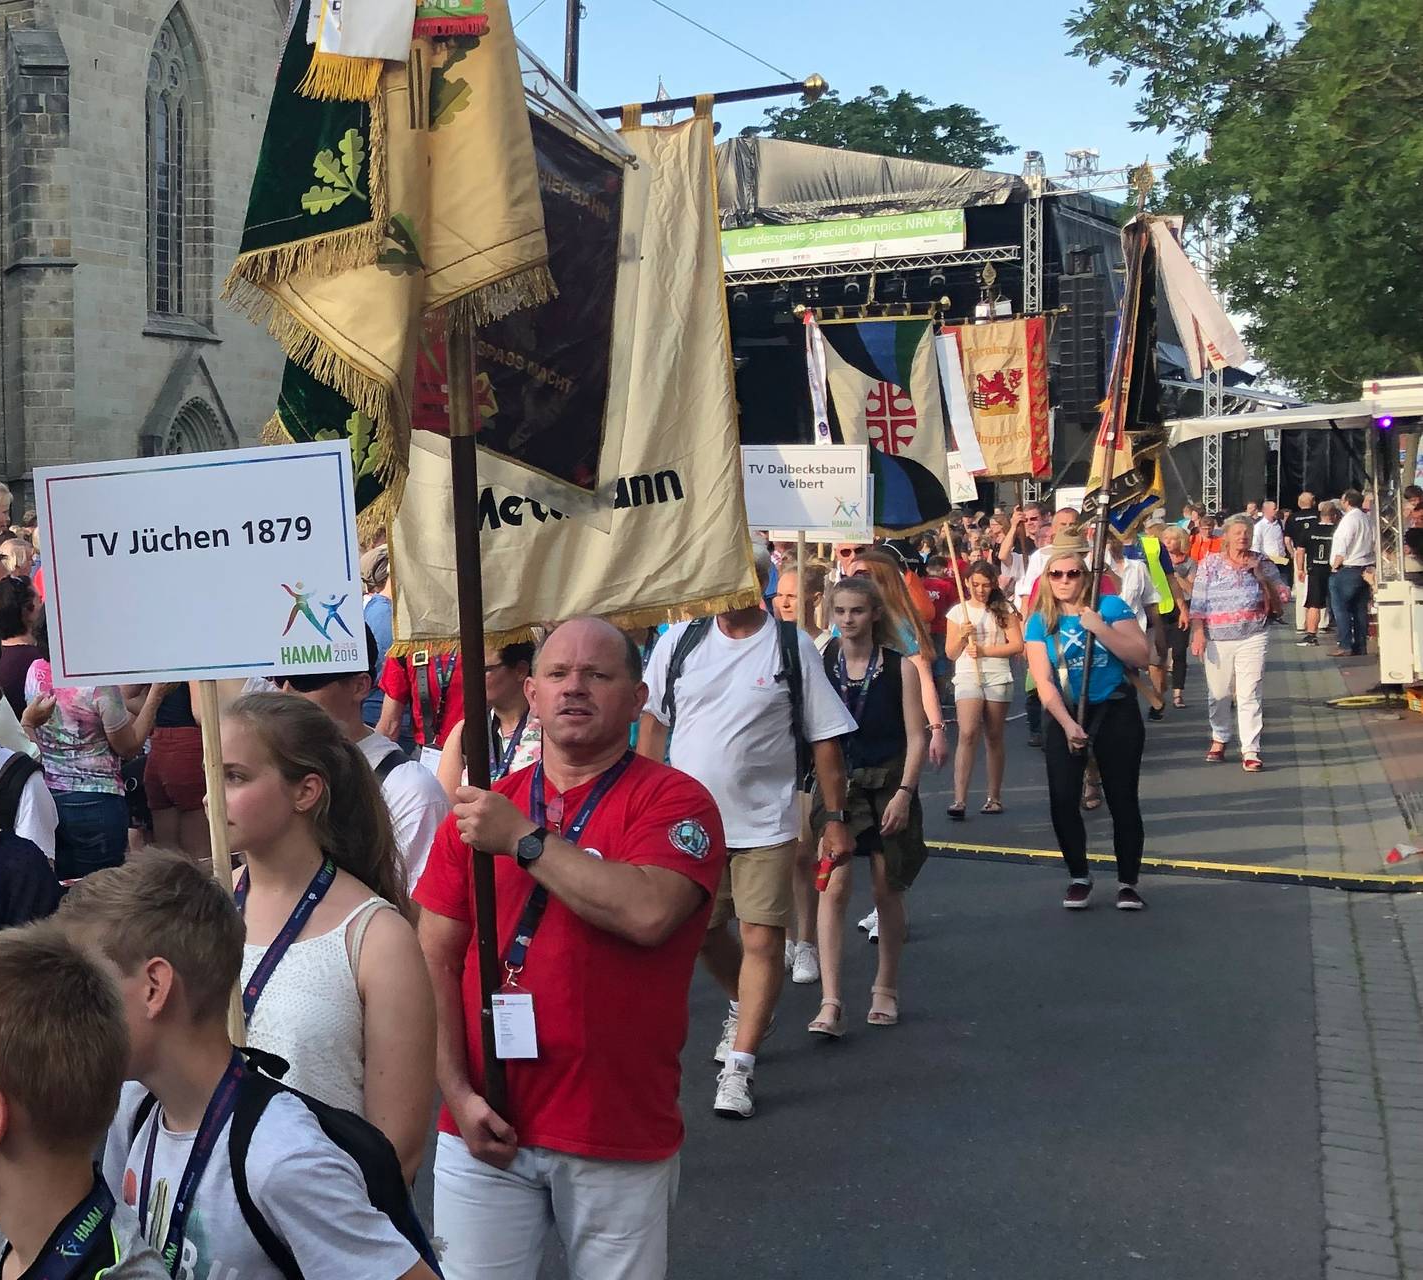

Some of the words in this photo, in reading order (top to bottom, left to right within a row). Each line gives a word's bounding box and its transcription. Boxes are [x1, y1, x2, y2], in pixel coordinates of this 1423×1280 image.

[737, 229, 806, 248] Landesspiele
[809, 222, 848, 242] Special
[850, 221, 903, 240] Olympics
[906, 215, 937, 230] NRW
[748, 464, 764, 474] TV
[768, 464, 856, 475] Dalbecksbaum
[780, 479, 824, 489] Velbert
[81, 532, 118, 557] TV
[129, 525, 230, 554] Jüchen
[241, 516, 312, 545] 1879
[281, 644, 333, 664] HAMM
[334, 649, 358, 662] 2019
[73, 1206, 105, 1242] HAMM
